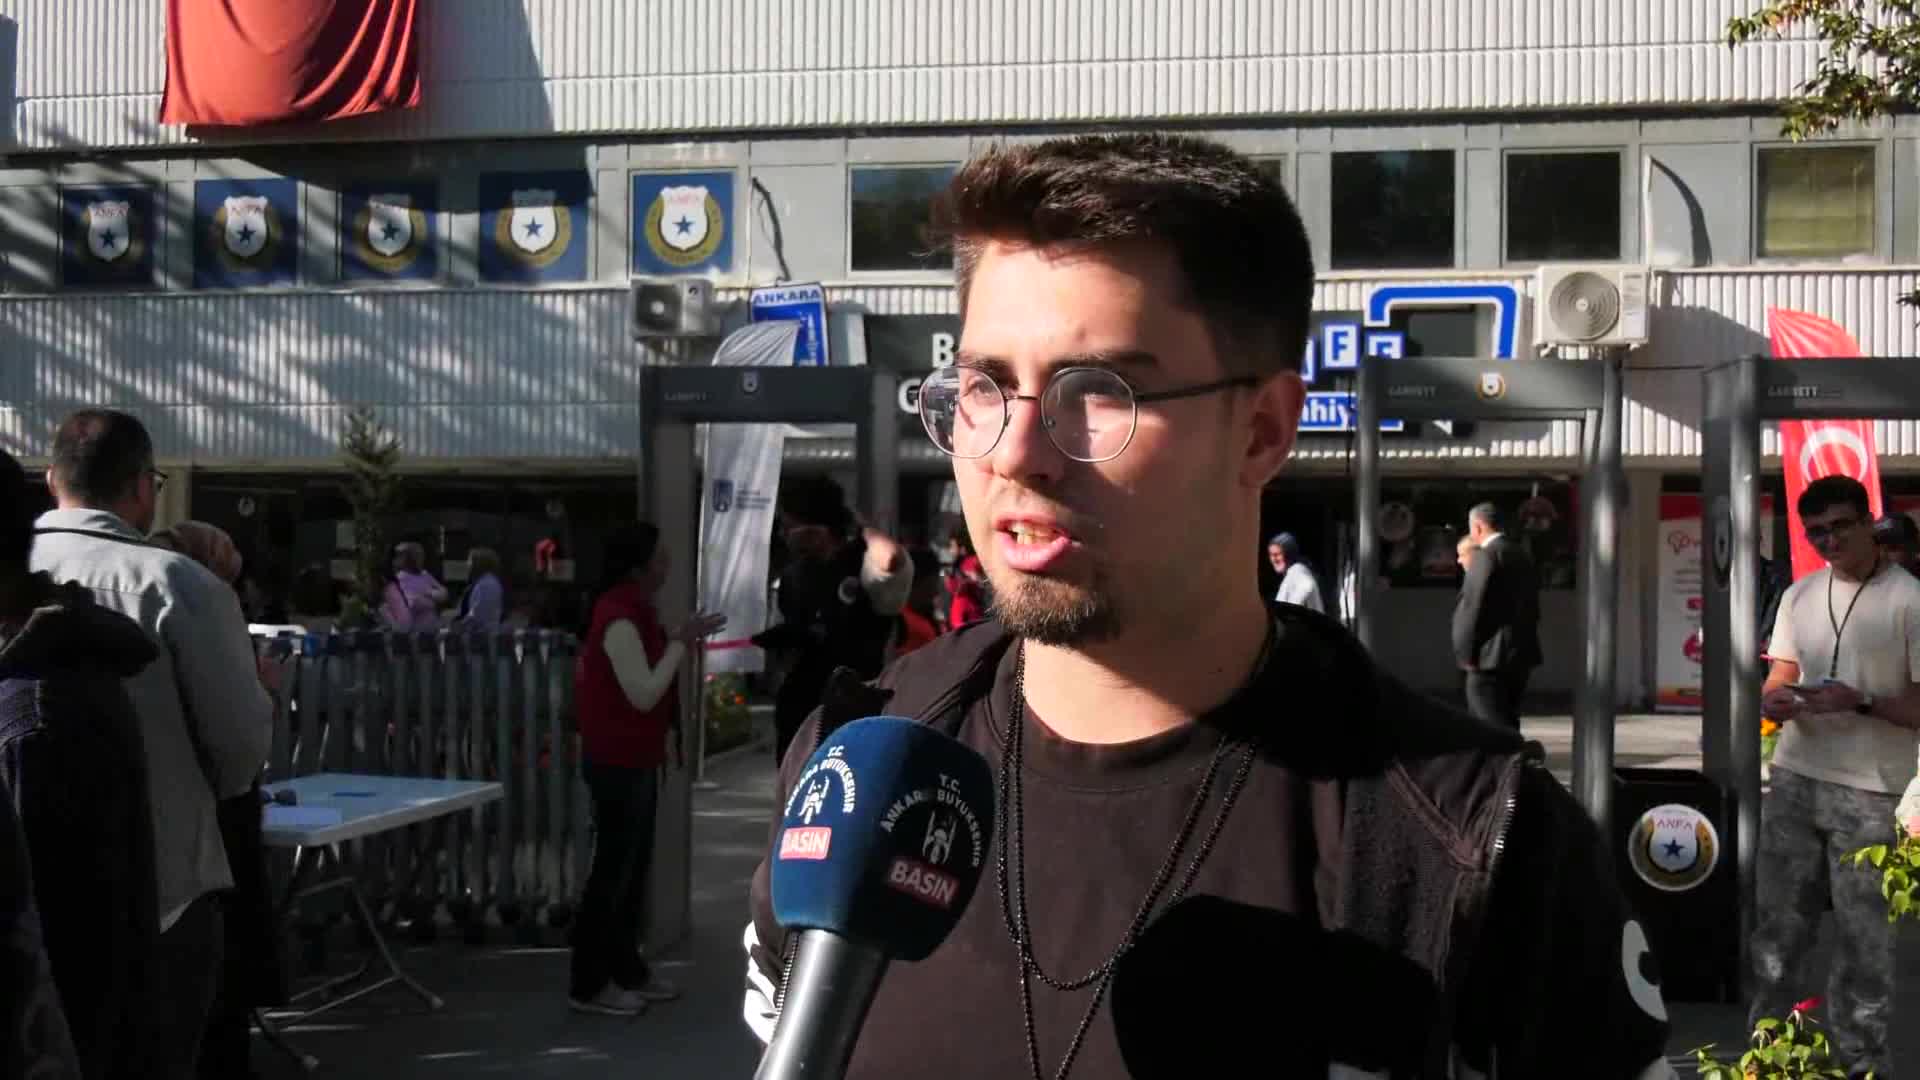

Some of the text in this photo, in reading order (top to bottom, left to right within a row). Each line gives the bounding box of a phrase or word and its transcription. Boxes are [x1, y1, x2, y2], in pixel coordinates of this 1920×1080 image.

[753, 288, 820, 305] ANKARA
[880, 790, 930, 833] ANKAR
[783, 830, 829, 853] BASIN
[890, 860, 957, 905] BASIN
